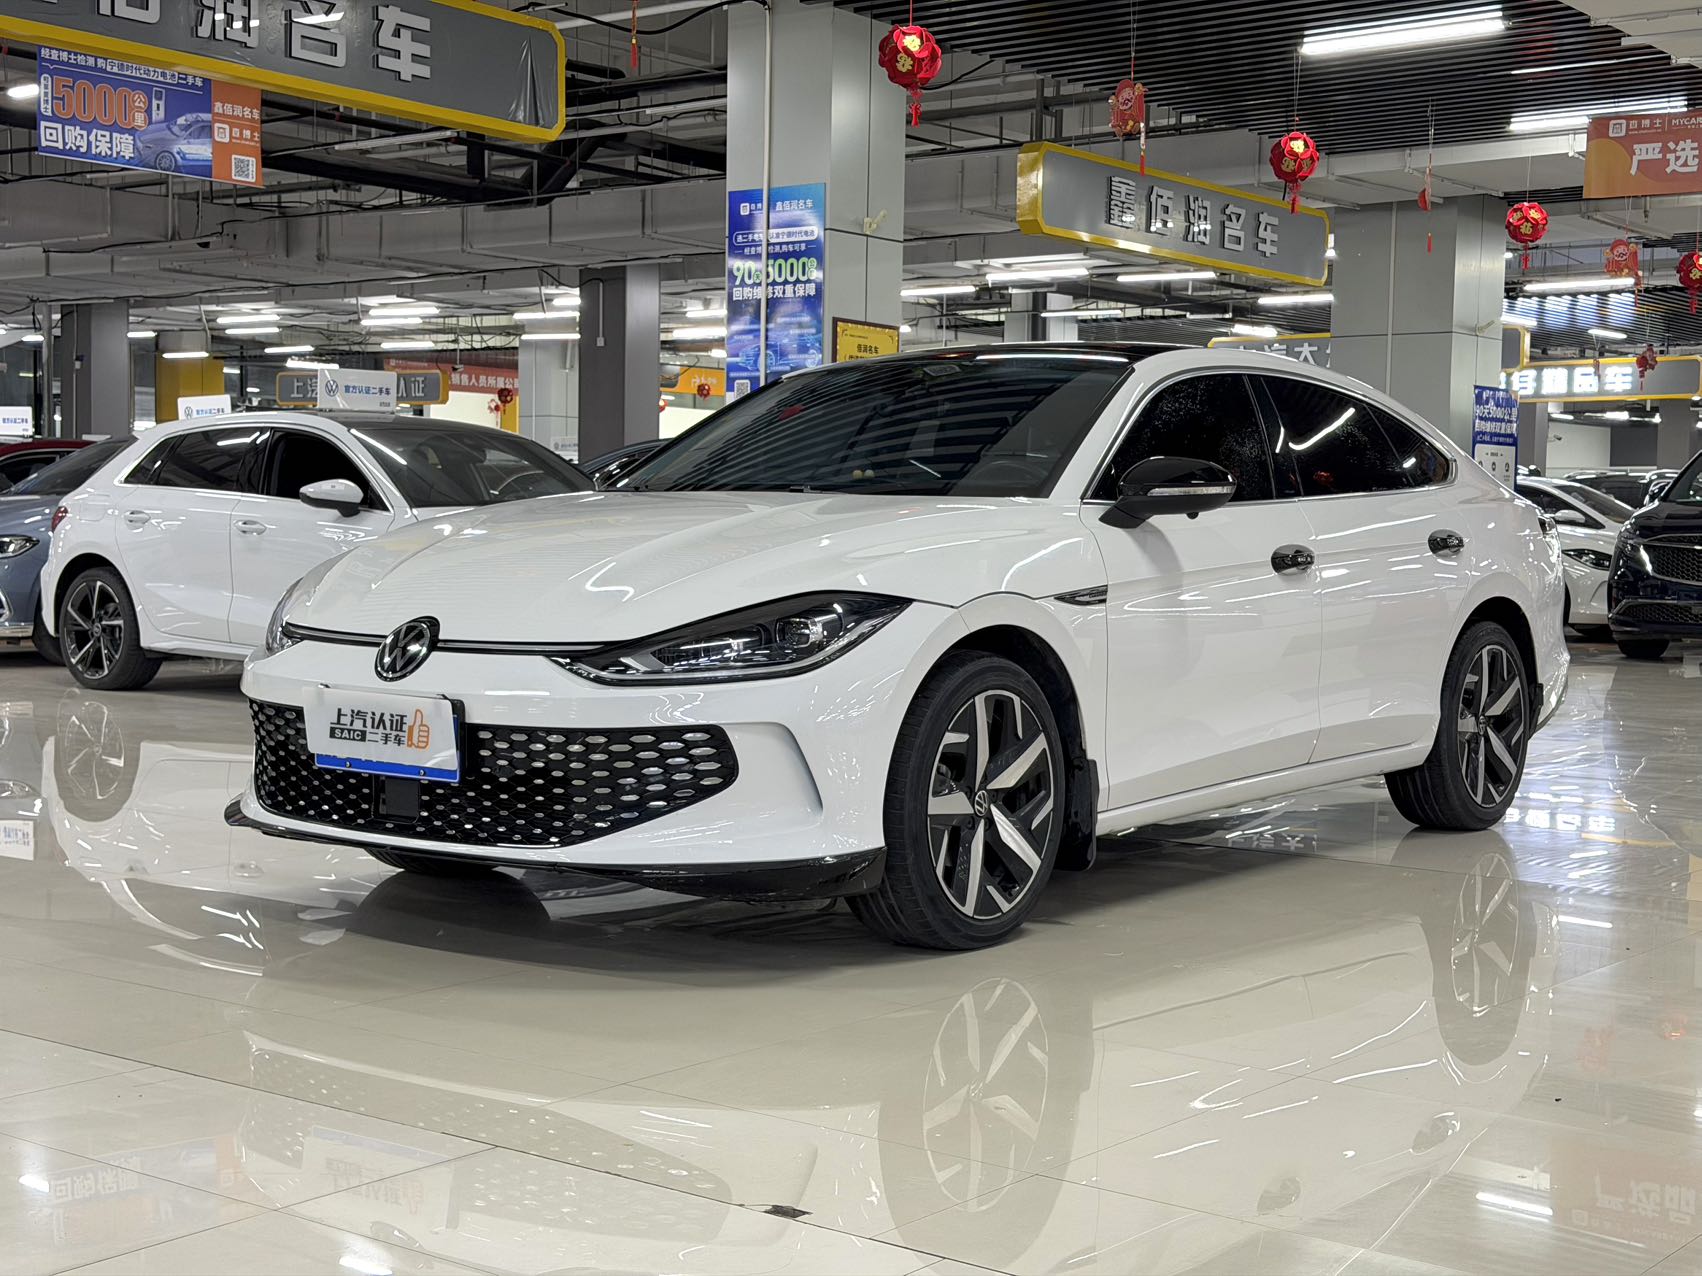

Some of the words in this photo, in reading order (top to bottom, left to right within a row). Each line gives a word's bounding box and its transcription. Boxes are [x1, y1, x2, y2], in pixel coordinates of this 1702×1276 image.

[214, 102, 260, 120] 鑫佰润名车
[40, 121, 135, 160] 回购保障
[1630, 138, 1699, 176] 严选
[1107, 176, 1279, 258] 鑫佰润名车
[344, 385, 391, 396] 官方认证二手车
[330, 708, 407, 732] 上汽认证
[334, 729, 362, 740] SAIC
[367, 731, 405, 747] 二手车
